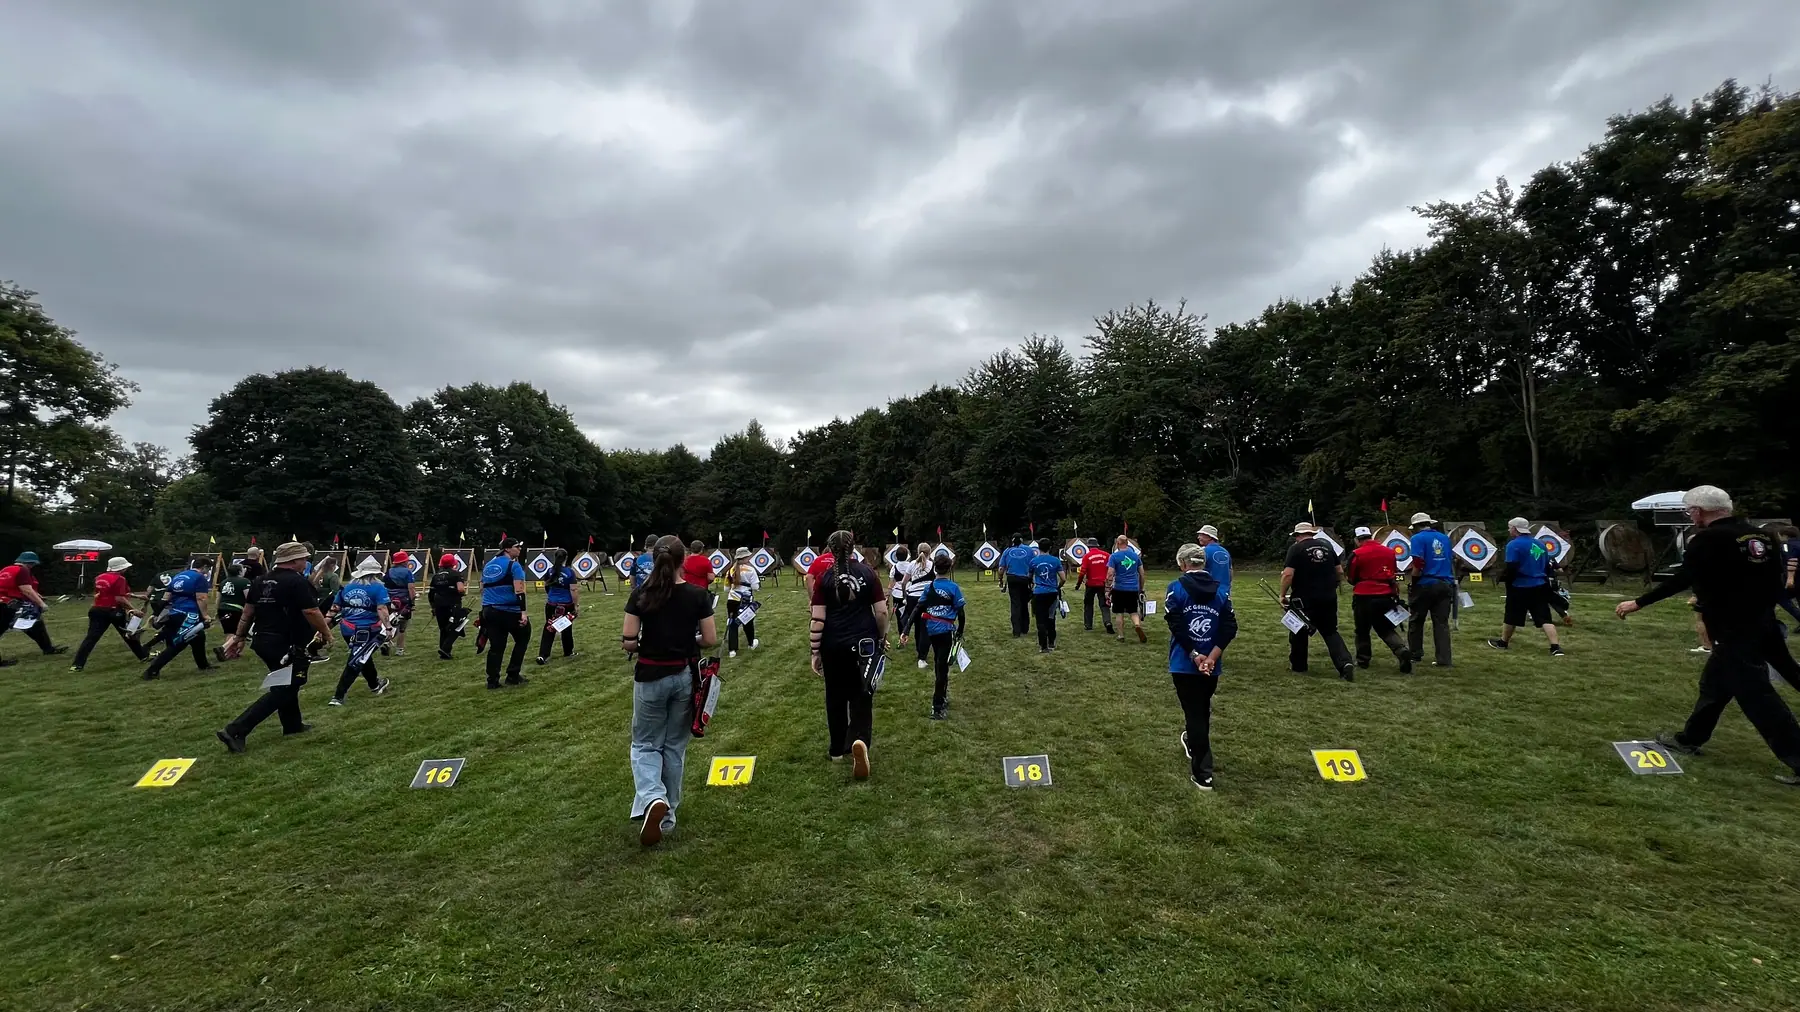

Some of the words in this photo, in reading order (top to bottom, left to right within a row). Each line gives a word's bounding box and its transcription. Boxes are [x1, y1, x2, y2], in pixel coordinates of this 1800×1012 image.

[1326, 759, 1356, 776] 19
[1630, 750, 1667, 768] 20
[152, 766, 182, 782] 15
[425, 766, 453, 784] 16
[719, 765, 746, 781] 17
[1013, 764, 1042, 781] 18
